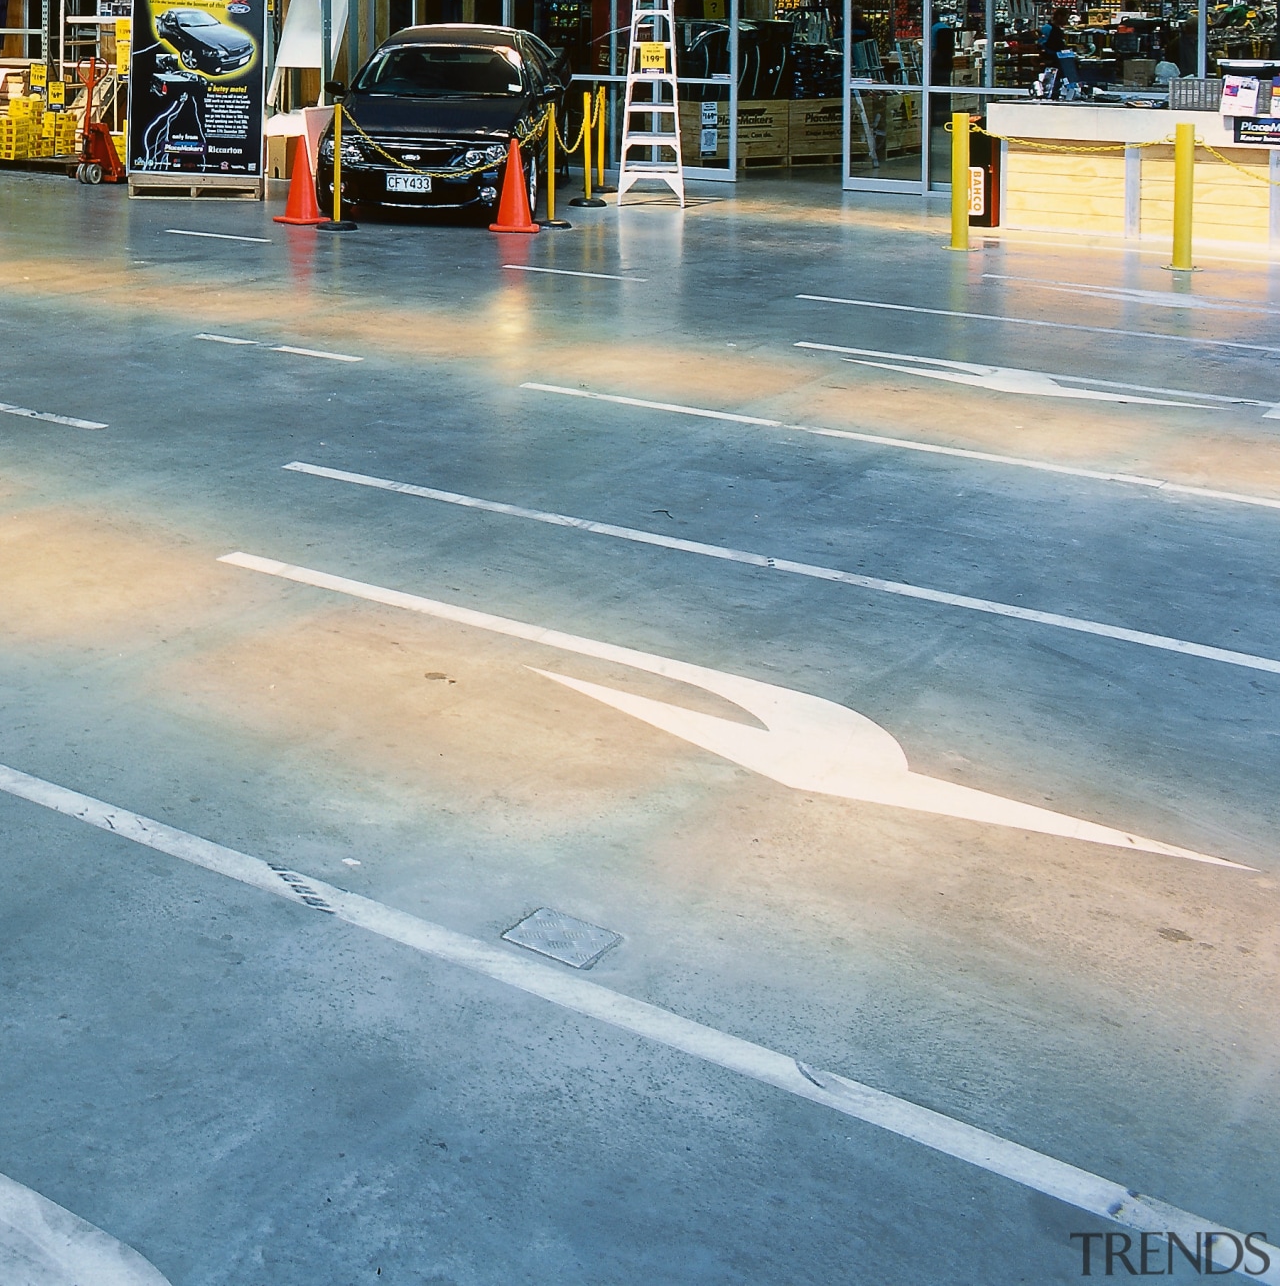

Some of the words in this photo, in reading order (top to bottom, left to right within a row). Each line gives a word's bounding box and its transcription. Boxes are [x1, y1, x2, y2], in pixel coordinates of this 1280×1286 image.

[717, 113, 774, 125] PlaeMakers
[164, 143, 204, 152] PlaceMakers
[208, 145, 243, 155] Riccarton
[388, 176, 430, 189] CFY433
[973, 171, 982, 212] BAHCO
